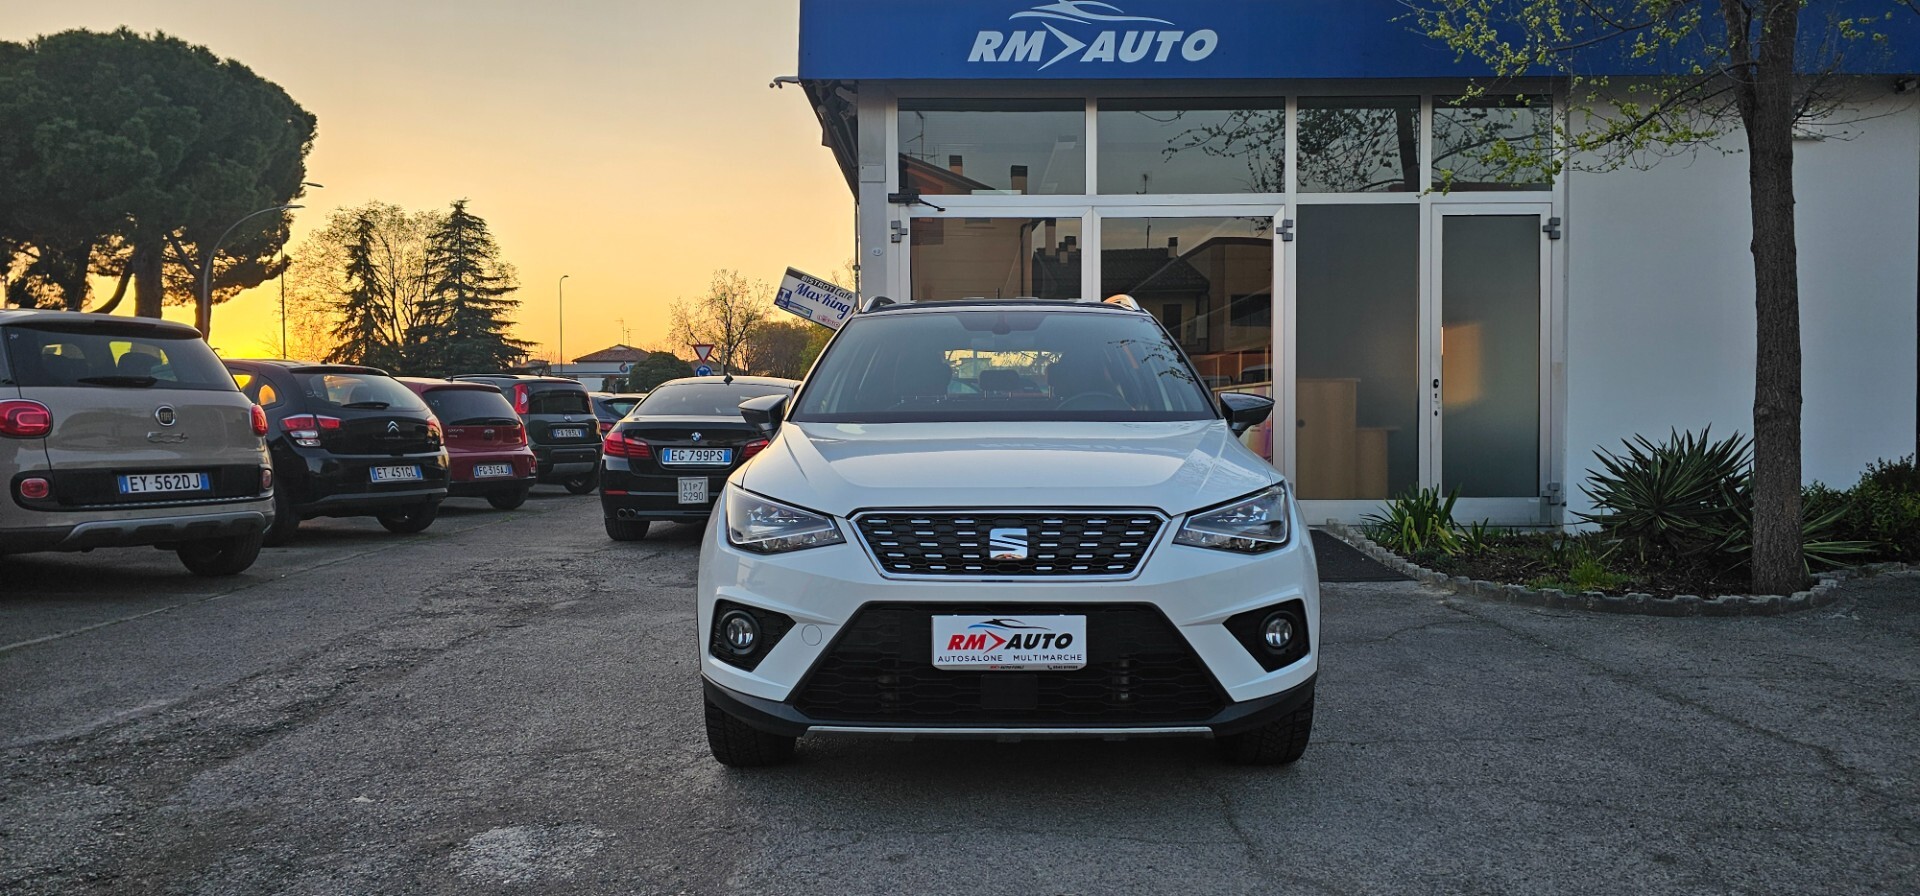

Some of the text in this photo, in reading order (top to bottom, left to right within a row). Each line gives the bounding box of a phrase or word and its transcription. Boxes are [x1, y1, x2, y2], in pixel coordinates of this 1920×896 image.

[967, 29, 1218, 63] RM AUTO
[801, 275, 836, 293] BISTROT
[689, 450, 723, 461] 799PS
[376, 466, 416, 479] ET 451GL
[129, 474, 200, 492] EY 562DJ
[683, 491, 704, 501] 5290
[947, 633, 1073, 650] RM AUTO
[937, 653, 1082, 662] AUTOSALONE MULTIMARCHE
